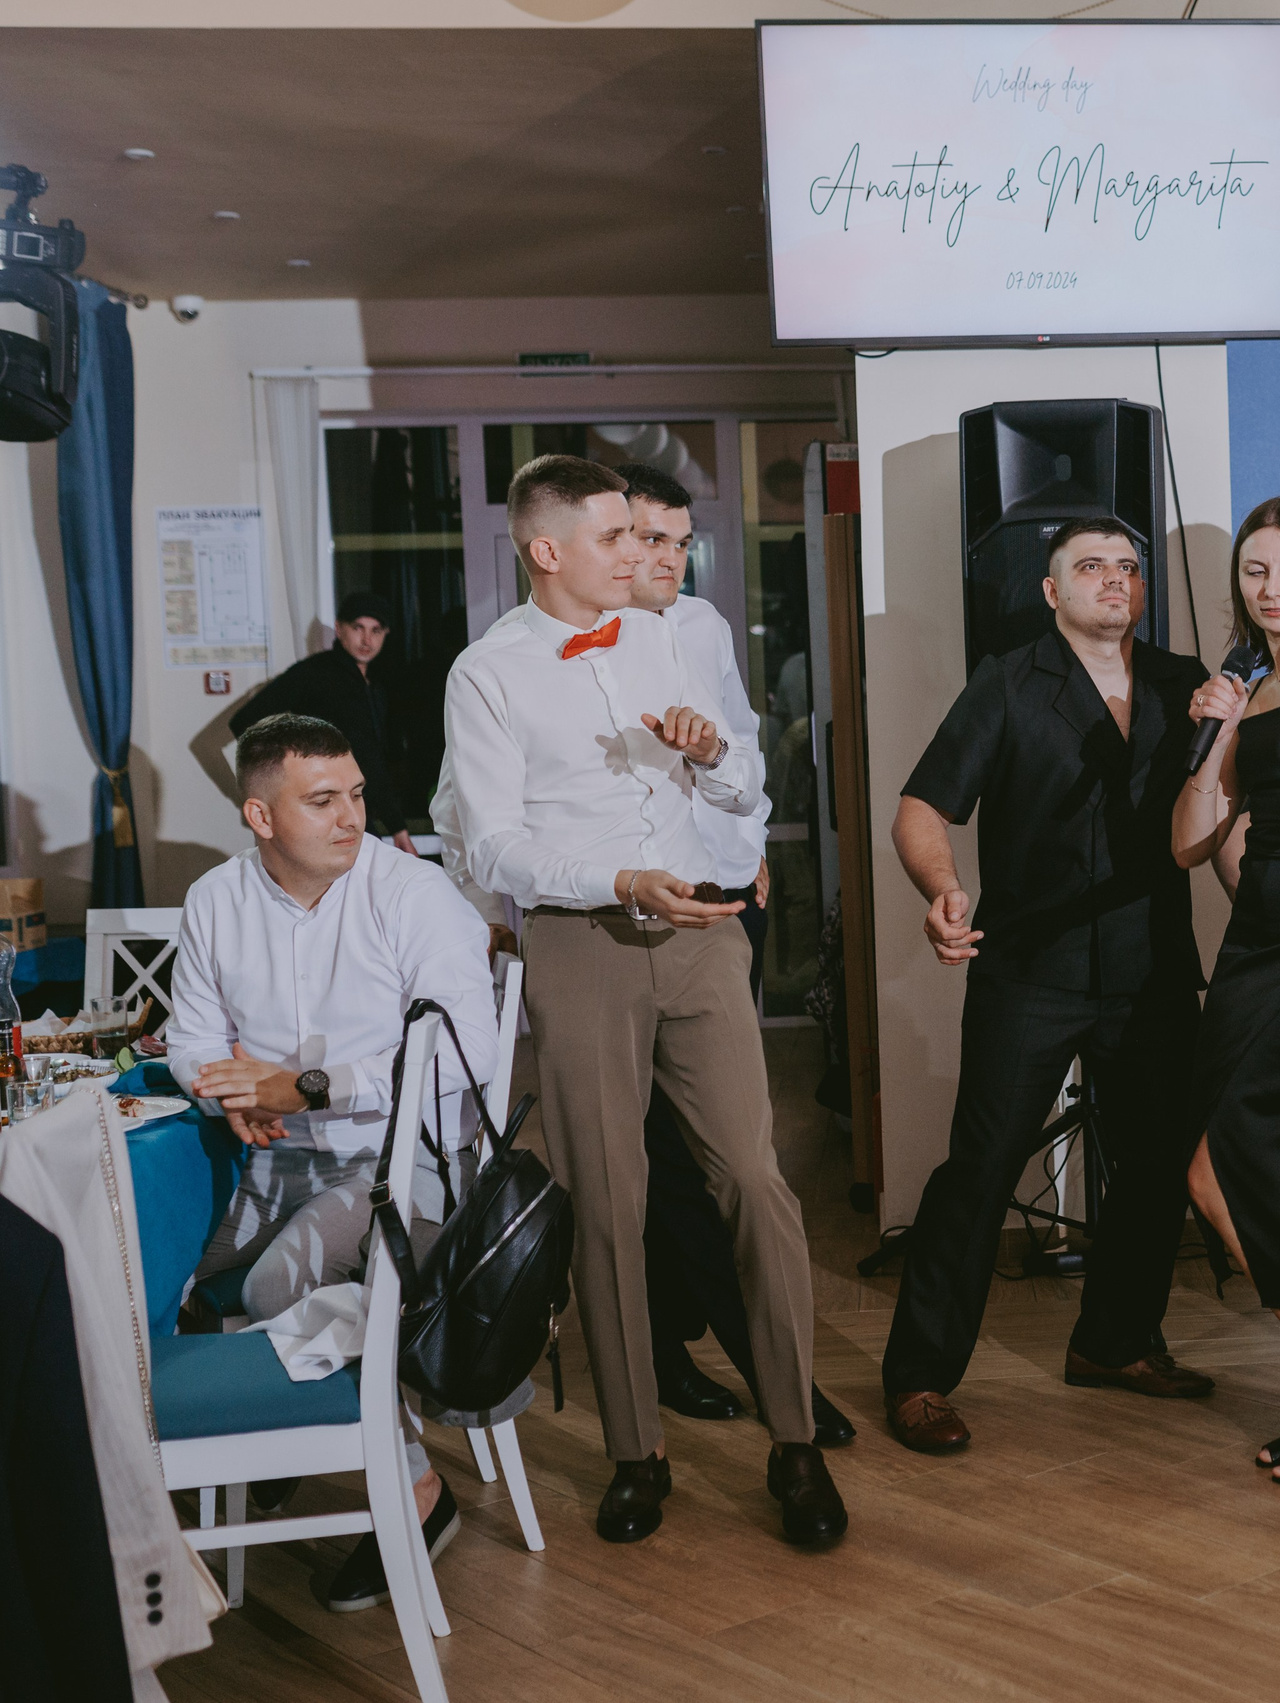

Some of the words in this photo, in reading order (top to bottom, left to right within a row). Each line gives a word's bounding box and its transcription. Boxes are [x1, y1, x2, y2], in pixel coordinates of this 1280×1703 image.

[972, 63, 1056, 112] Wedding
[1061, 66, 1094, 114] day
[997, 168, 1019, 204] &
[1038, 143, 1269, 241] Margarita
[1005, 270, 1078, 290] 07.09.2024
